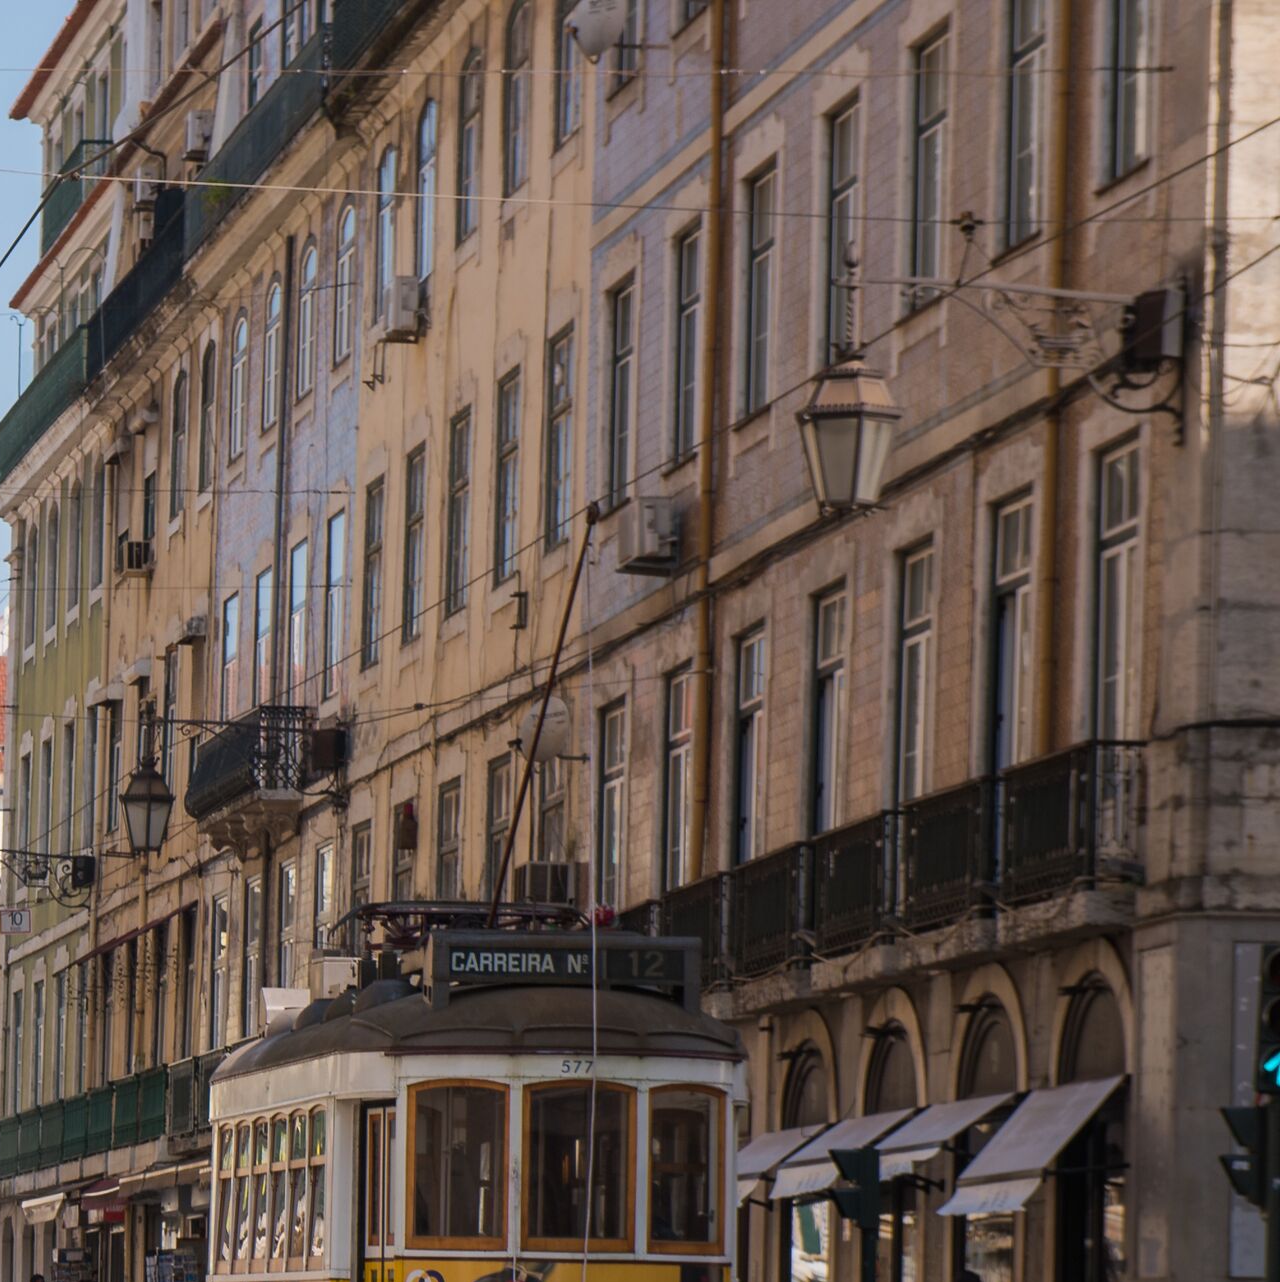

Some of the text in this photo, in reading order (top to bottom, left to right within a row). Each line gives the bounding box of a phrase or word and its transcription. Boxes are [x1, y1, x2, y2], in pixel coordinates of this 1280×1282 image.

[8, 911, 23, 926] 10
[451, 951, 555, 973] CARREIRA
[629, 952, 665, 977] 12
[561, 1060, 594, 1074] 577
